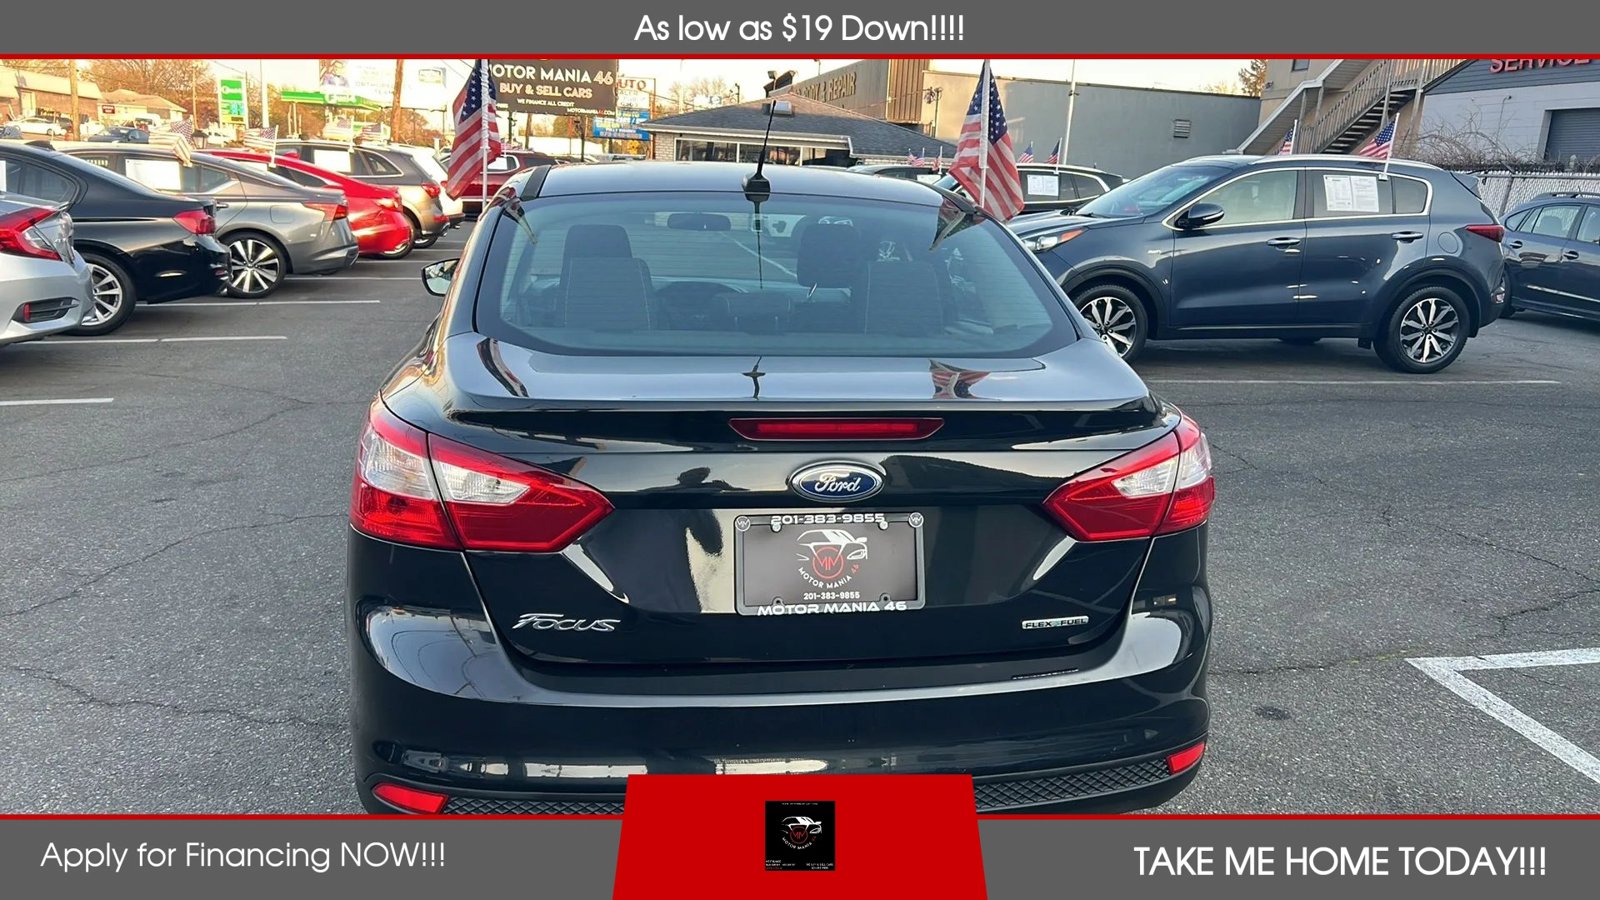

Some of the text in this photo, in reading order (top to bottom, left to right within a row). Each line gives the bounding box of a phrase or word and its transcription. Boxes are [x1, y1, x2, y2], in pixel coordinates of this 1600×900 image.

[1490, 59, 1590, 73] SERV
[541, 67, 591, 83] MANIA
[593, 70, 614, 85] 46
[500, 82, 592, 98] BUY & SELL CARS
[617, 79, 646, 91] UTO
[828, 72, 856, 101] REPAIR
[814, 472, 861, 493] Ford
[771, 513, 885, 525] 201-383-9855
[798, 567, 823, 588] MOTOR
[827, 575, 852, 588] MANIA
[803, 591, 860, 600] 201-383-9855
[757, 601, 907, 616] MOTOR MANIA 46
[1025, 618, 1087, 629] FLEX FUEL
